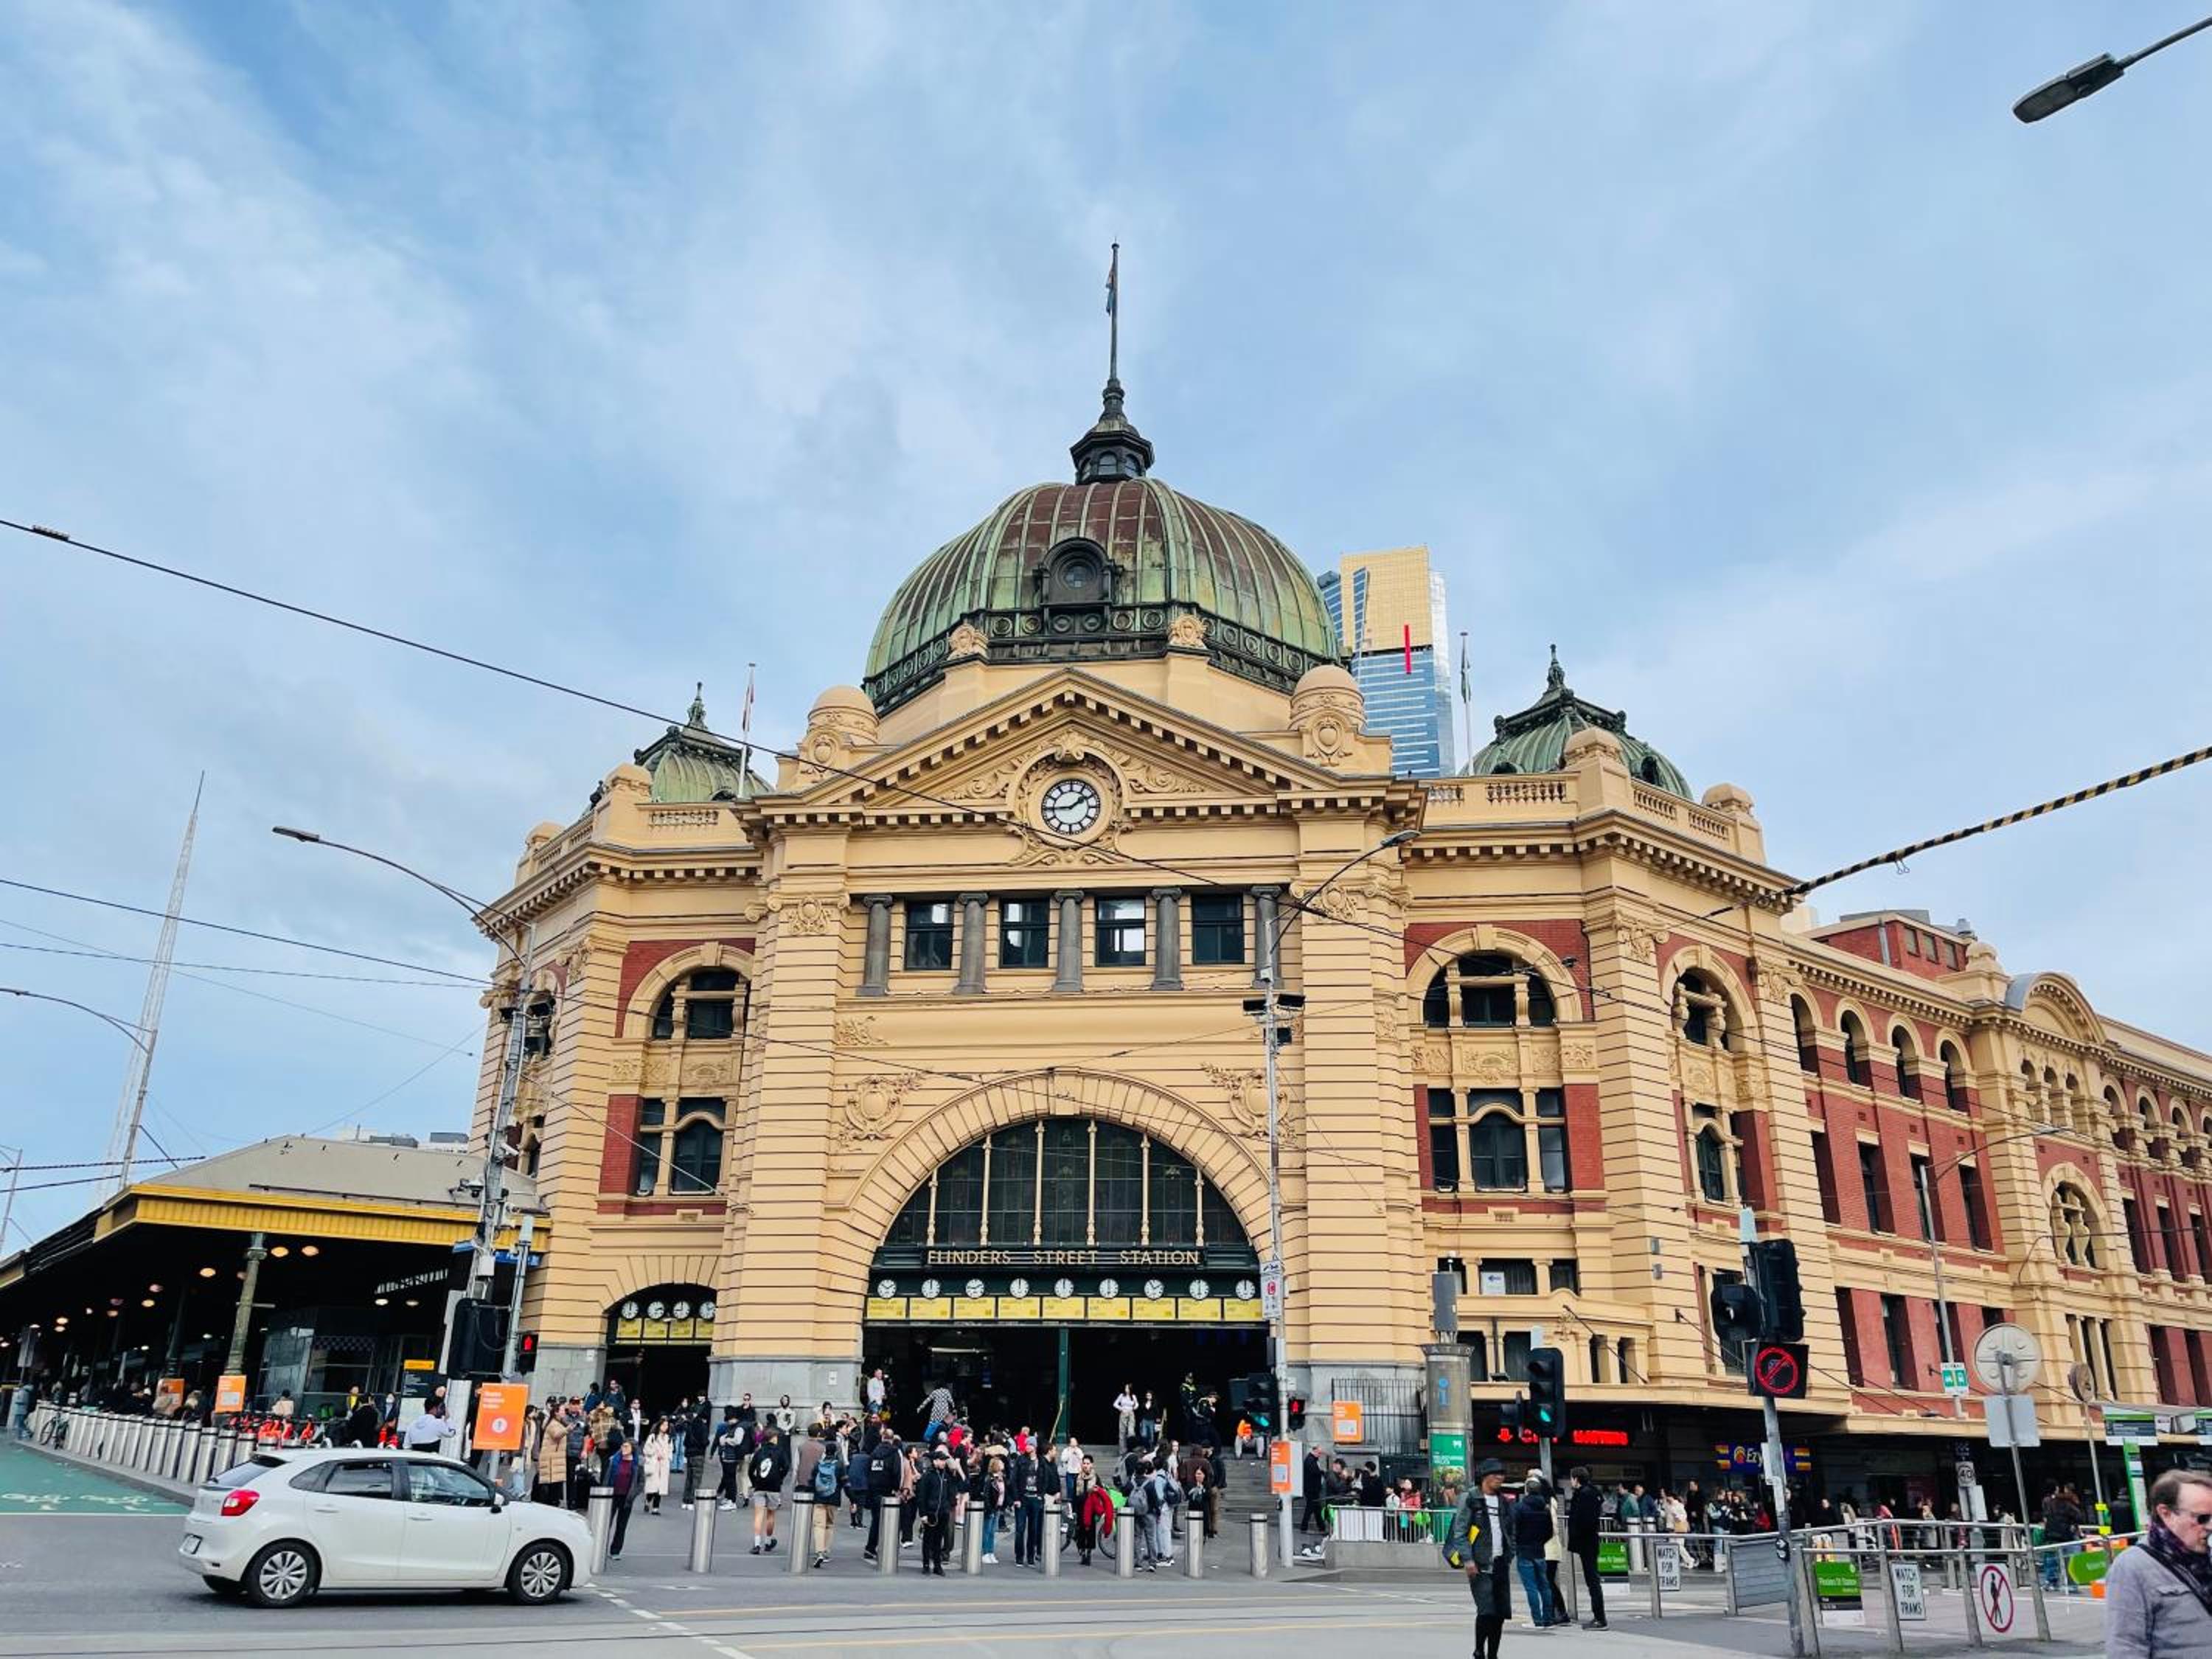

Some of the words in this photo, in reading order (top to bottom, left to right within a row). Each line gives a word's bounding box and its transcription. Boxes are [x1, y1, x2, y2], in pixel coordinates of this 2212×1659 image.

[927, 1250, 1012, 1265] FLINDERS
[1033, 1250, 1098, 1265] STREET
[1120, 1250, 1200, 1265] STATION
[1894, 1568, 1916, 1582] WATCH
[1902, 1585, 1915, 1597] FOR
[1900, 1602, 1922, 1615] TRAMS
